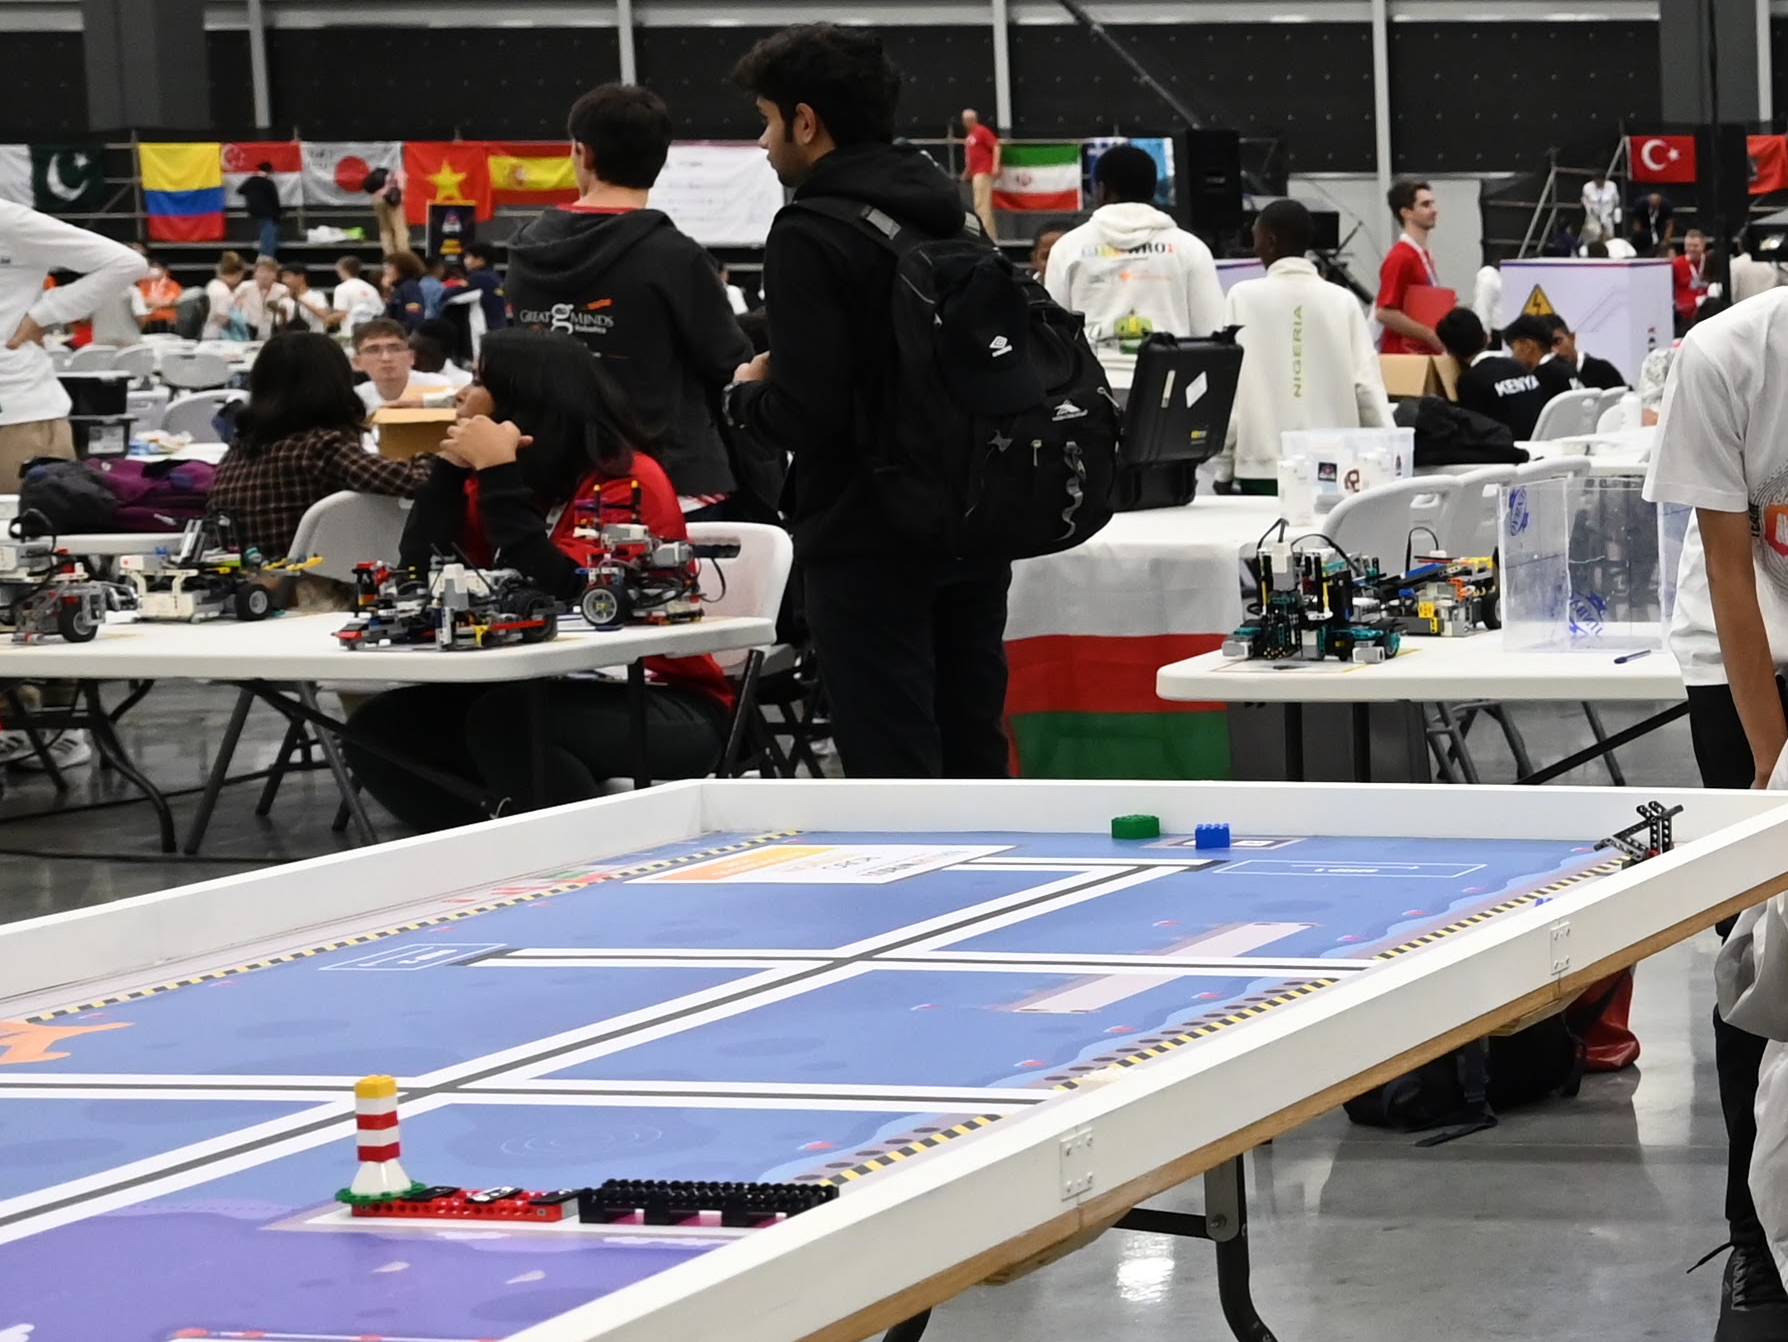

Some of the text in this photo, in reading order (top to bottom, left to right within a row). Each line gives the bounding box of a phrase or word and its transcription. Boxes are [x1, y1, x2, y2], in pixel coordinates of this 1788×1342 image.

[520, 309, 551, 323] GREAT
[570, 311, 615, 328] MINDS
[1291, 304, 1303, 399] NIGERIA
